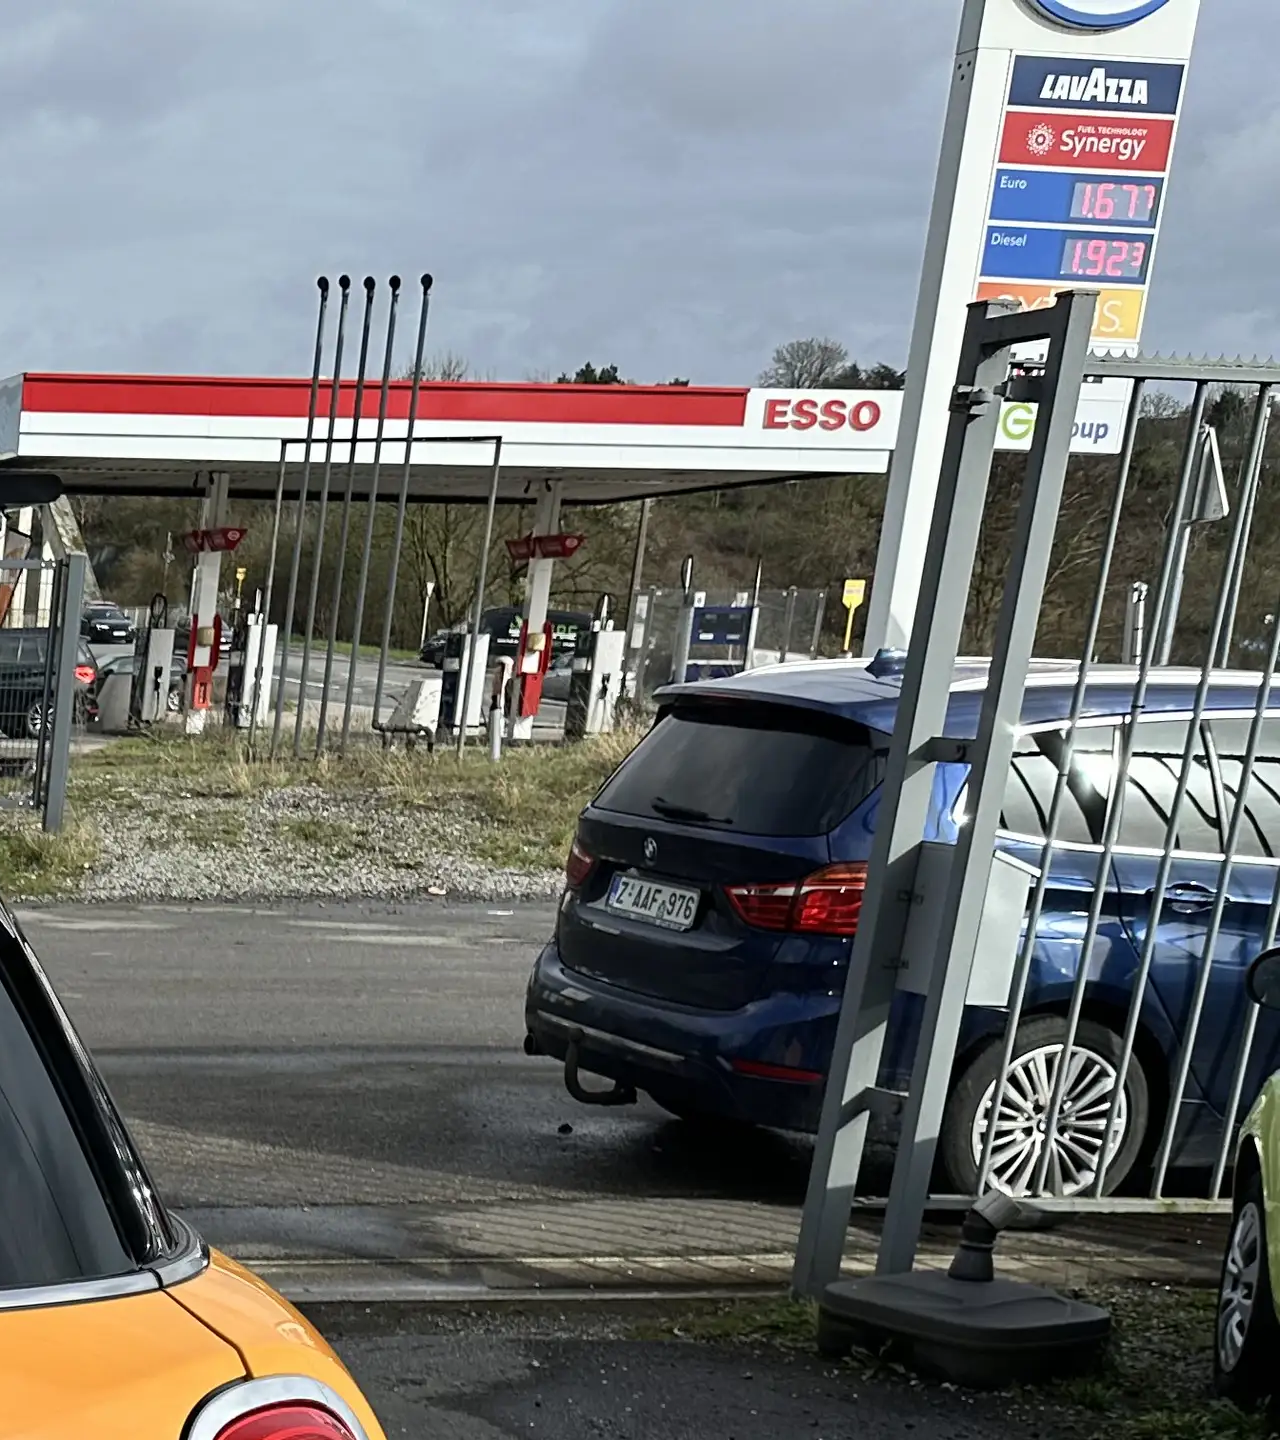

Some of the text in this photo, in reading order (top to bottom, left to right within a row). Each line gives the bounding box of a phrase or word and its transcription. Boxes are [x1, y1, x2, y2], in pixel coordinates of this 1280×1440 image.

[1039, 67, 1148, 105] LAVAZZA
[1077, 125, 1148, 137] FUEL TECHNOLOGY
[1060, 130, 1147, 161] Synergy
[1000, 176, 1027, 190] Euro
[991, 233, 1027, 247] Diesel
[762, 398, 881, 432] ESSO
